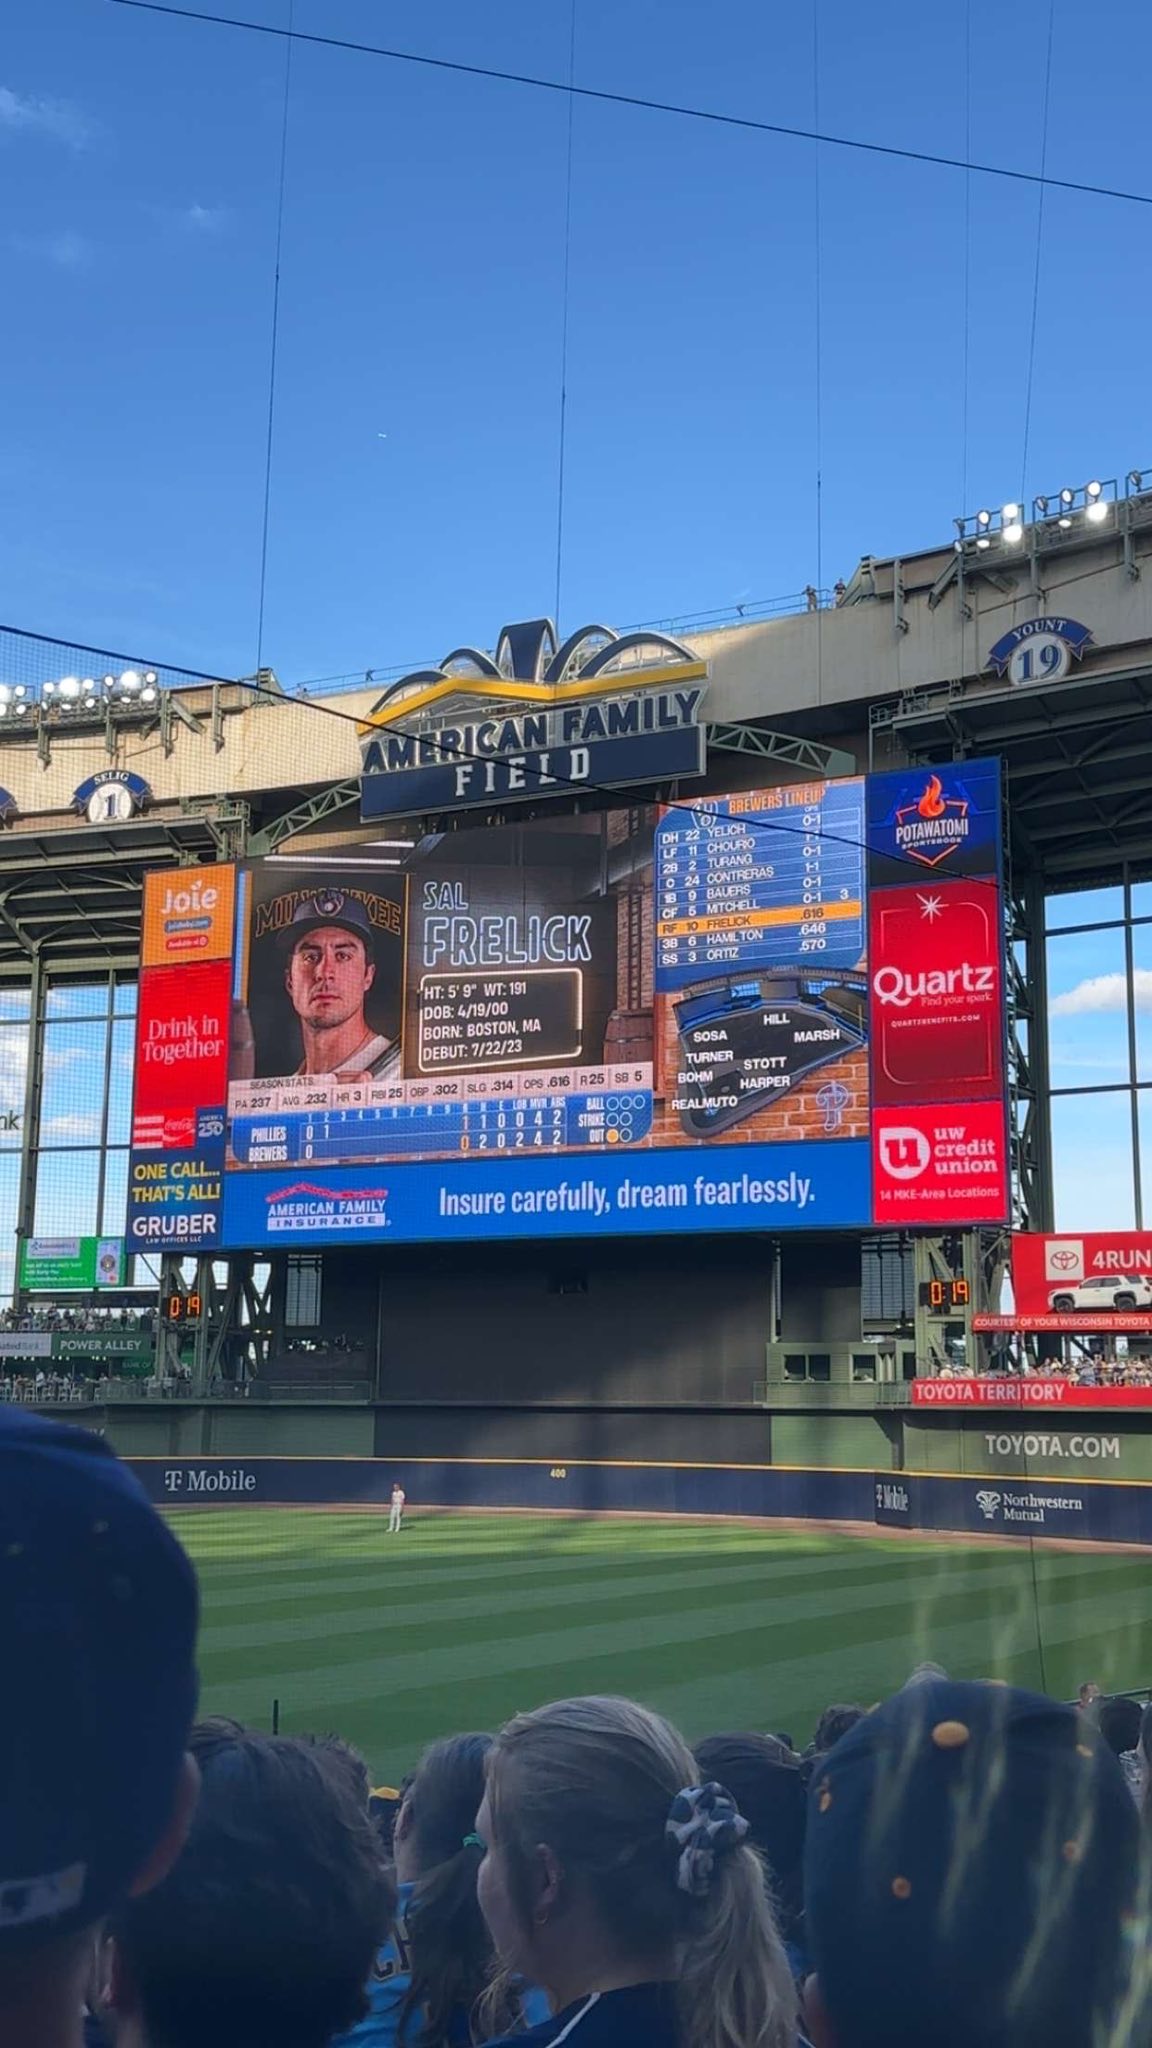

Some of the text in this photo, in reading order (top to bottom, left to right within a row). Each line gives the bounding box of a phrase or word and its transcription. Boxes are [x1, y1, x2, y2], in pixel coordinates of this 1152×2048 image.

[1012, 620, 1067, 640] YOUNT
[1018, 645, 1061, 682] 19
[364, 690, 700, 772] AMERICAN FAMILY
[94, 771, 129, 785] SELIG
[456, 748, 590, 797] FIELD
[104, 793, 118, 820] 1
[729, 784, 825, 814] BREWERS LINEUP
[662, 815, 821, 844] DH 22 YELICH 0-1
[896, 819, 968, 844] POTAWATOMI
[663, 839, 755, 859] LF 11 CHOURIO
[663, 845, 821, 874] 2B 2 TURANG 0-1
[666, 862, 819, 888] C 24 CONTRERAS 1-1
[160, 880, 218, 914] Joie
[423, 882, 469, 911] SAL
[664, 877, 821, 904] 1B 9 BAUERS 0-1
[662, 889, 849, 919] CF 5 MITCHELL 0-1 3
[663, 923, 677, 934] RF
[686, 922, 698, 932] 10
[707, 916, 750, 929] FRELICK
[423, 915, 592, 966] FRELICK
[663, 922, 826, 949] 3B 6 HAMILTON .646
[662, 953, 678, 964] SS
[688, 952, 697, 962] 3
[707, 948, 739, 960] ORTIZ
[424, 982, 527, 1000] HT: 5' 9" WT: 191
[874, 963, 994, 1006] Quartz
[424, 1002, 509, 1020] DOB: 4/19/00
[763, 1013, 790, 1025] HILL
[149, 1014, 219, 1040] Drink in
[423, 1019, 542, 1040] BORN: BOSTON, MA
[693, 1030, 728, 1043] SOSA
[794, 1029, 840, 1043] MARSH
[143, 1037, 224, 1065] Together
[423, 1039, 522, 1061] DEBUT: 7/22/23
[686, 1050, 733, 1064] TURNER
[744, 1056, 787, 1070] STOTT
[250, 1077, 313, 1089] SEASON STATS
[678, 1071, 713, 1084] BOHM
[740, 1076, 790, 1089] HARPER
[235, 1071, 642, 1109] PA 237 AVG .232 HR 3 RBI 25 OBP .302 SLG .314 OPS .616 R 25 SB 5
[587, 1097, 605, 1110] BALL
[672, 1096, 738, 1110] REALMUTO
[198, 1121, 224, 1137] 250
[252, 1110, 561, 1143] PHILLIES 0 1 1 0 0 4 2
[579, 1114, 605, 1127] STRIKE
[590, 1130, 604, 1143] OUT
[934, 1127, 966, 1140] uw
[249, 1130, 561, 1162] BREWERS 0 0 2 0 2 4 2
[934, 1139, 995, 1157] credit
[134, 1161, 220, 1180] ONE CALL...
[934, 1157, 998, 1175] union
[132, 1183, 221, 1202] THAT'S ALL!
[439, 1171, 815, 1216] Insure carefully, dream fearlessly.
[880, 1186, 1000, 1200] 14 MKE-Area Locations
[268, 1200, 386, 1217] AMERICAN FAMILY
[132, 1213, 217, 1237] GRUBER
[276, 1216, 376, 1227] INSURANCE
[1092, 1250, 1152, 1269] 4RUN
[1020, 1317, 1033, 1326] OF
[1034, 1317, 1058, 1326] YOUR
[1060, 1316, 1112, 1326] WISCONSIN
[1114, 1316, 1150, 1326] TOYOTA
[60, 1340, 142, 1351] POWER ALLEY
[916, 1384, 1065, 1401] TOYOTA TERRITORY
[985, 1434, 1120, 1459] TOYOTA.COM
[165, 1470, 256, 1491] T Mobile
[550, 1469, 566, 1478] 400
[1003, 1493, 1083, 1510] Northwestern
[1003, 1508, 1045, 1523] Mutual
